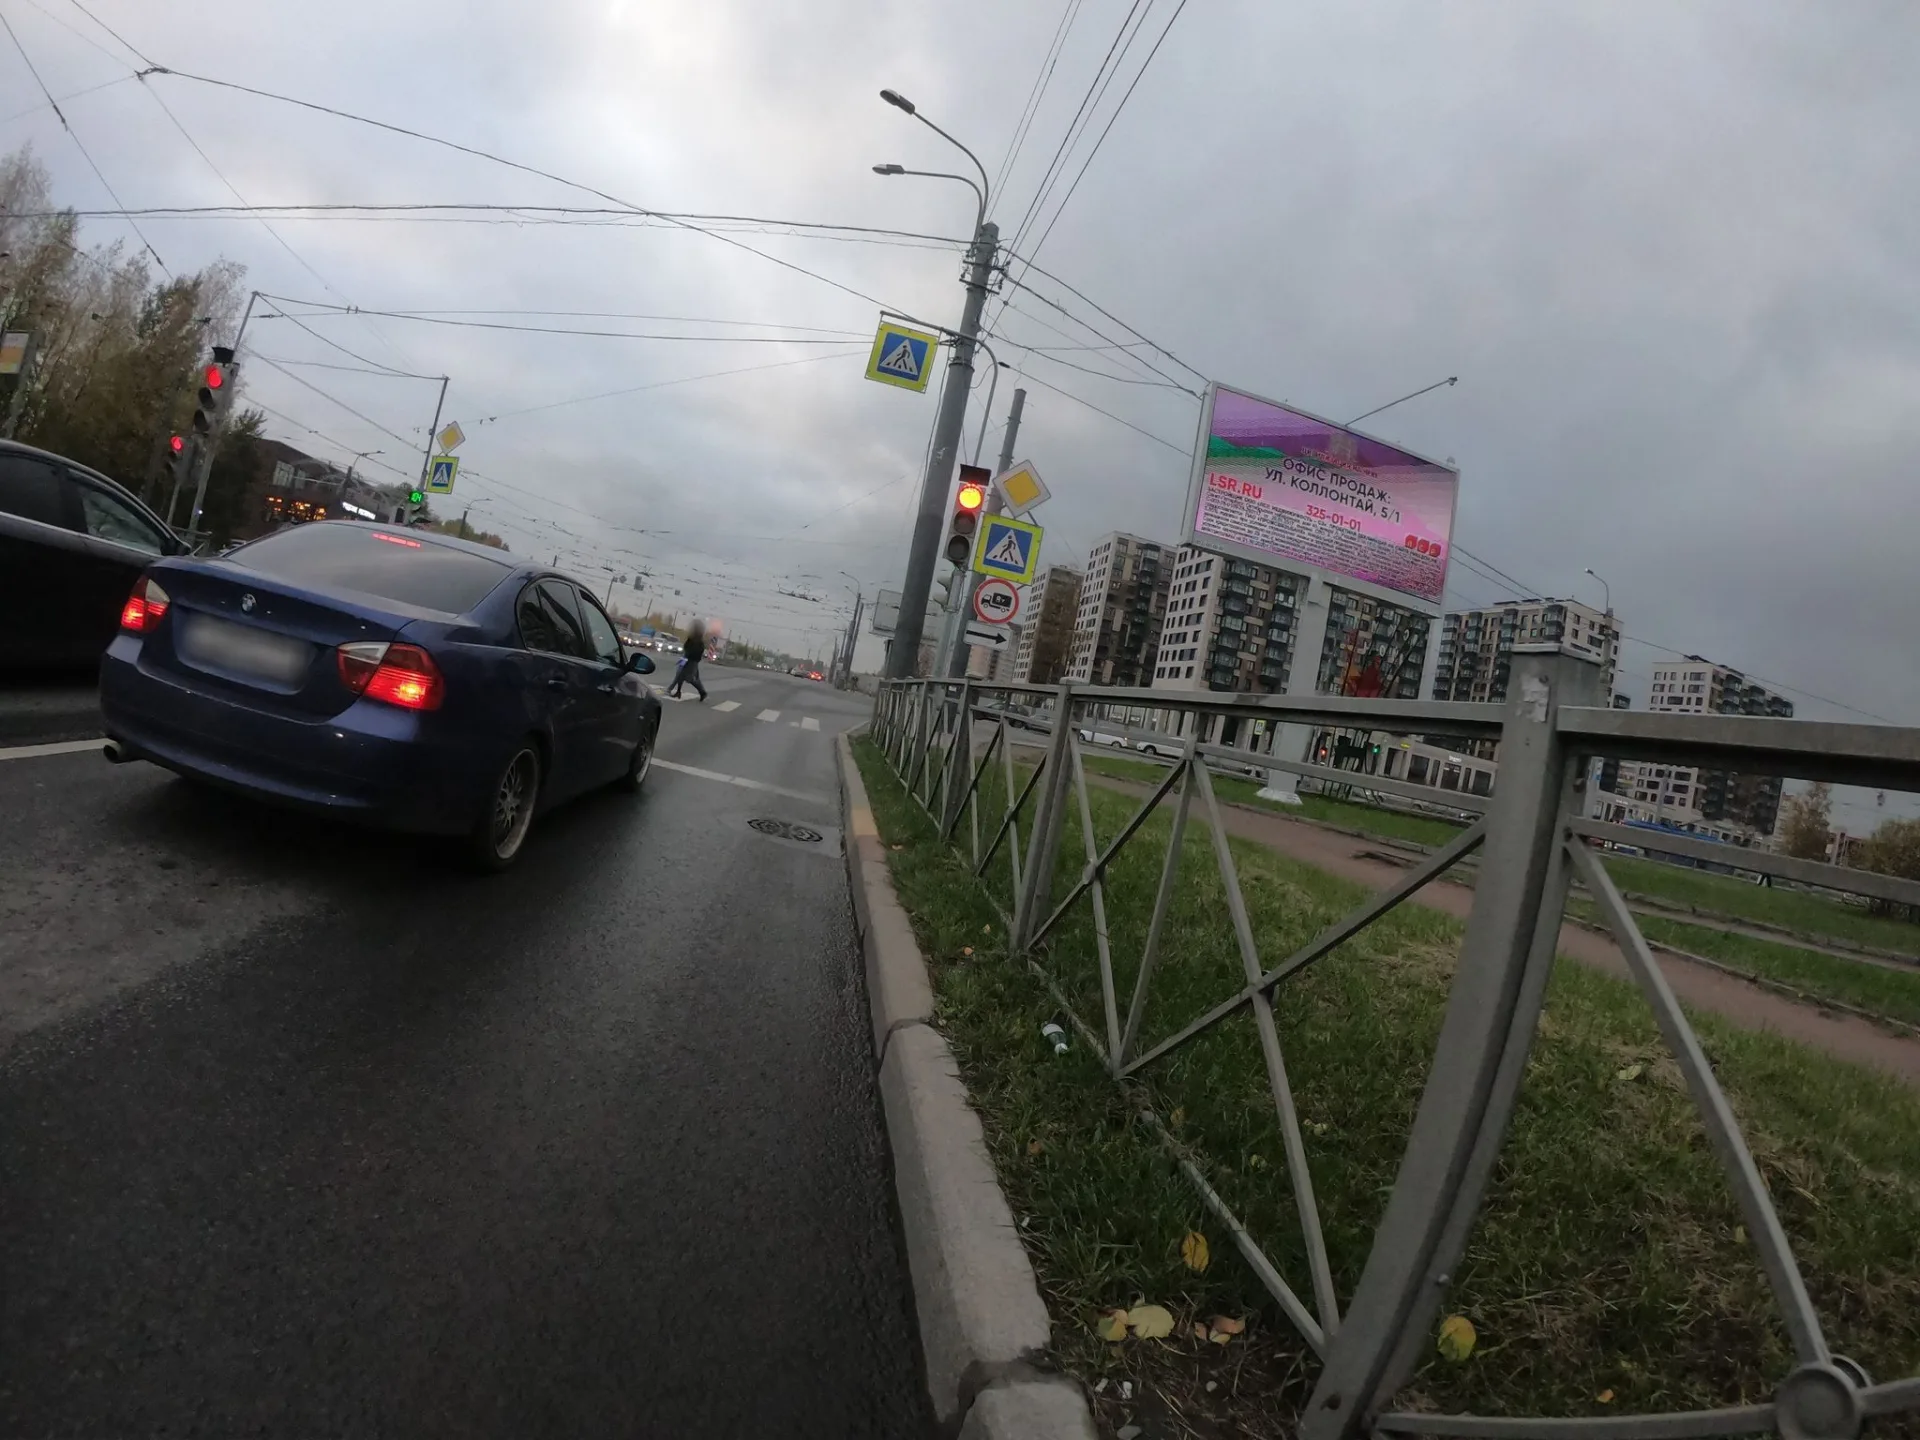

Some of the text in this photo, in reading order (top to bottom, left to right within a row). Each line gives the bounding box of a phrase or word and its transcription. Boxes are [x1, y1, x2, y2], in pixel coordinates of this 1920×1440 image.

[1209, 472, 1263, 499] LSR.RU
[1265, 467, 1401, 523] УЛ. КОЛЛОНТАЙ, 5/1
[1283, 458, 1326, 482] ОФИС
[1330, 473, 1392, 504] ПРОДАЖ:
[1306, 504, 1362, 532] 325-01-01
